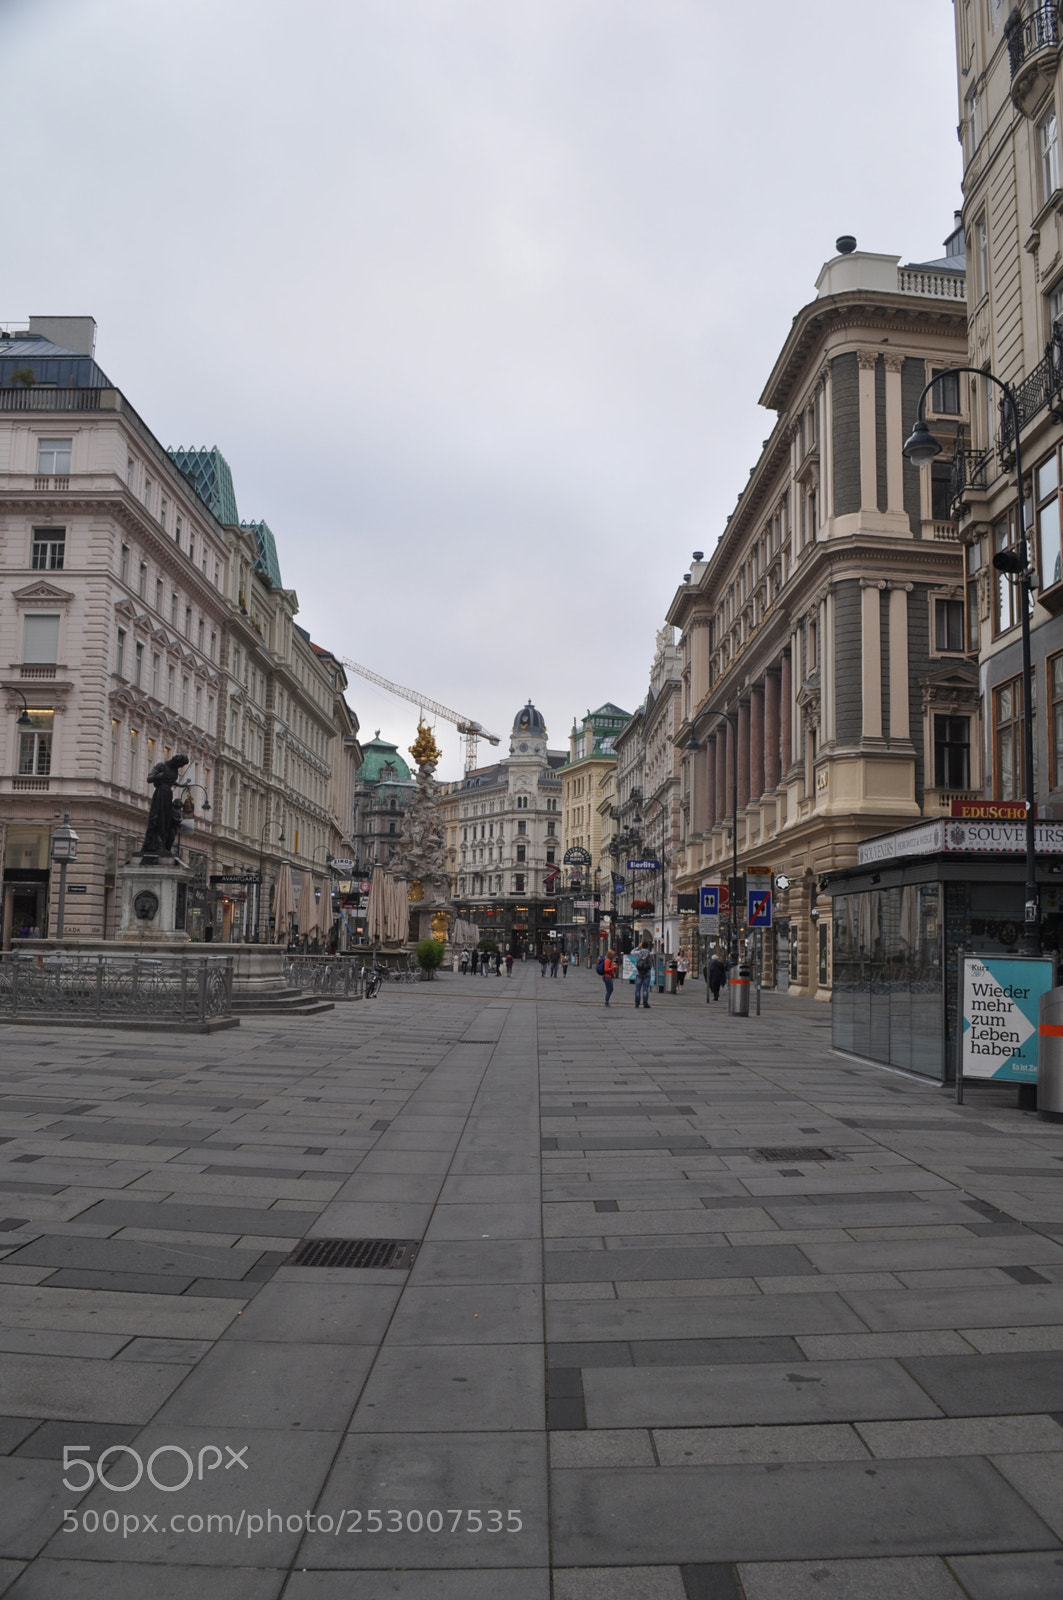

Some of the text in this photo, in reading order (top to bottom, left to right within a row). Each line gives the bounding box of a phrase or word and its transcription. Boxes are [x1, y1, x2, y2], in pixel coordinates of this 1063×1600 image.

[864, 842, 893, 861] SOUVENIRS
[972, 983, 1030, 999] Wieder
[971, 999, 1014, 1012] mehr
[971, 1015, 1005, 1026] zum
[971, 1027, 1020, 1042] Leben
[970, 1041, 1026, 1058] haben.
